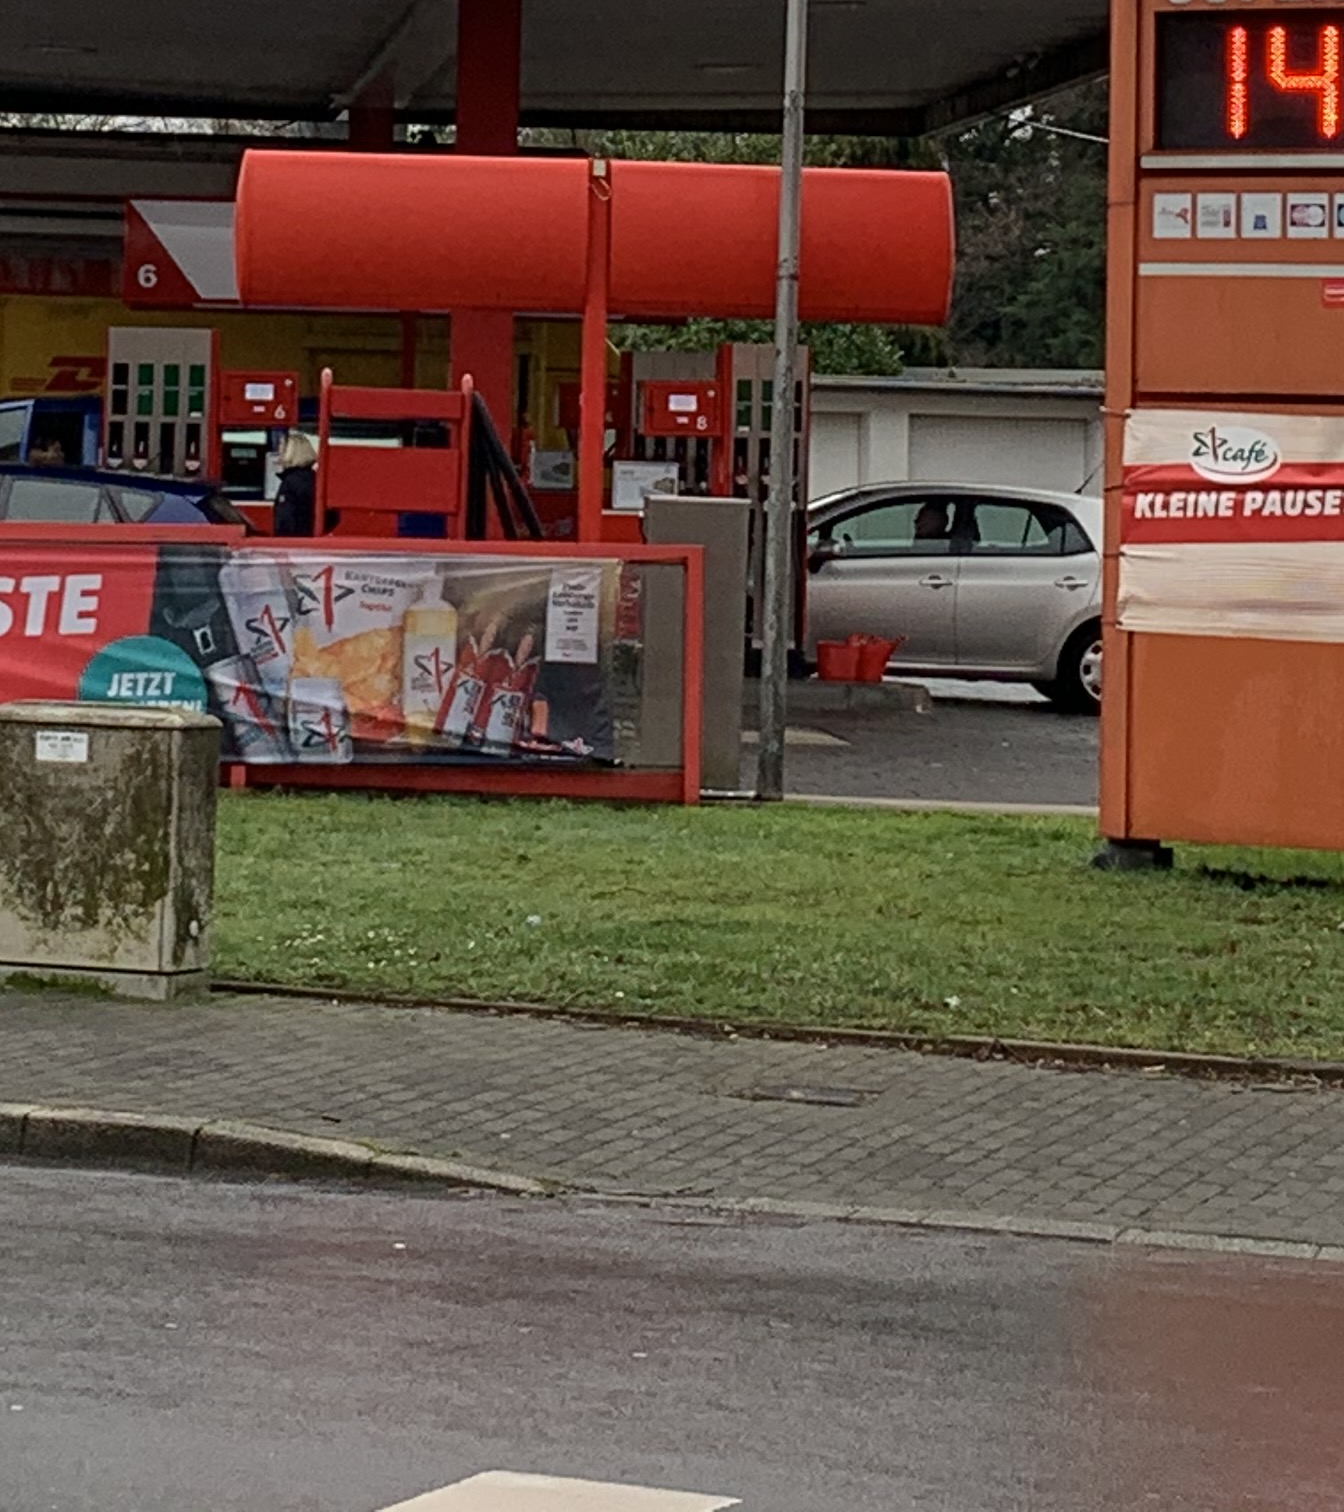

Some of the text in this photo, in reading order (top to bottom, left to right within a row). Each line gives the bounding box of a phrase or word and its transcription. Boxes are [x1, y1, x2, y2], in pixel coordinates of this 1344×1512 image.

[137, 263, 158, 288] 6
[274, 404, 286, 419] 6
[696, 414, 708, 431] 8
[1222, 439, 1269, 471] café
[1134, 492, 1237, 519] KLEINE
[106, 671, 177, 698] JETZT
